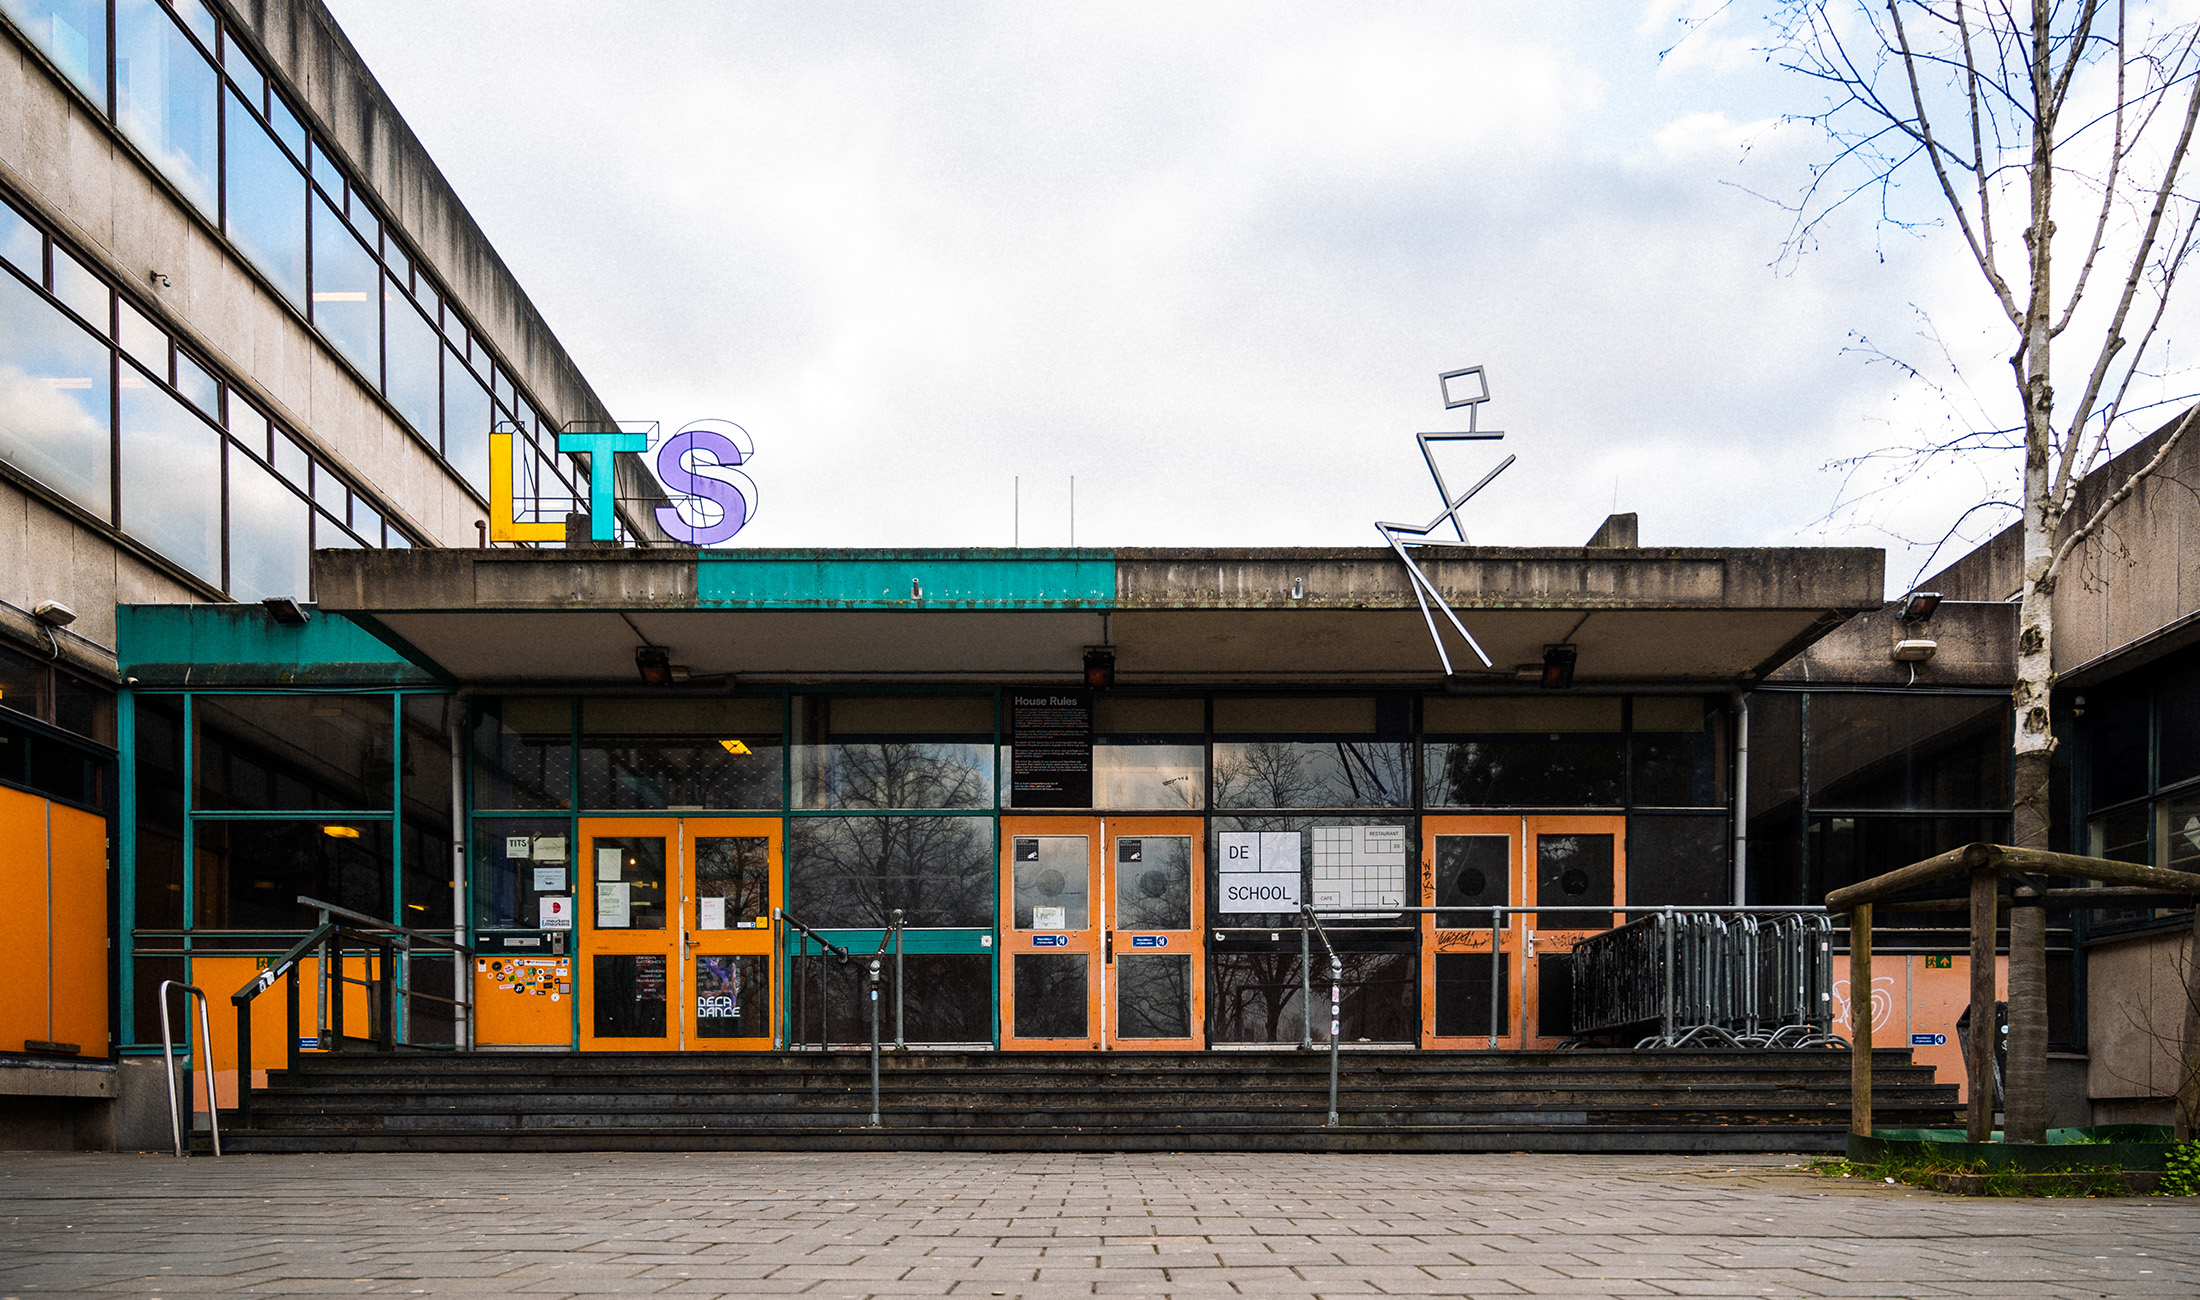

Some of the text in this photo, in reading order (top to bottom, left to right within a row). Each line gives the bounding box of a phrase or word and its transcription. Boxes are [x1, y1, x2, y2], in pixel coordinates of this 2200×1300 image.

[490, 431, 746, 545] LTS
[1015, 696, 1078, 706] House Rules
[509, 839, 527, 847] TITS
[1229, 845, 1249, 859] DE
[1228, 886, 1292, 900] SCHOOL
[697, 996, 732, 1007] DECA
[697, 1006, 741, 1018] DANCE
